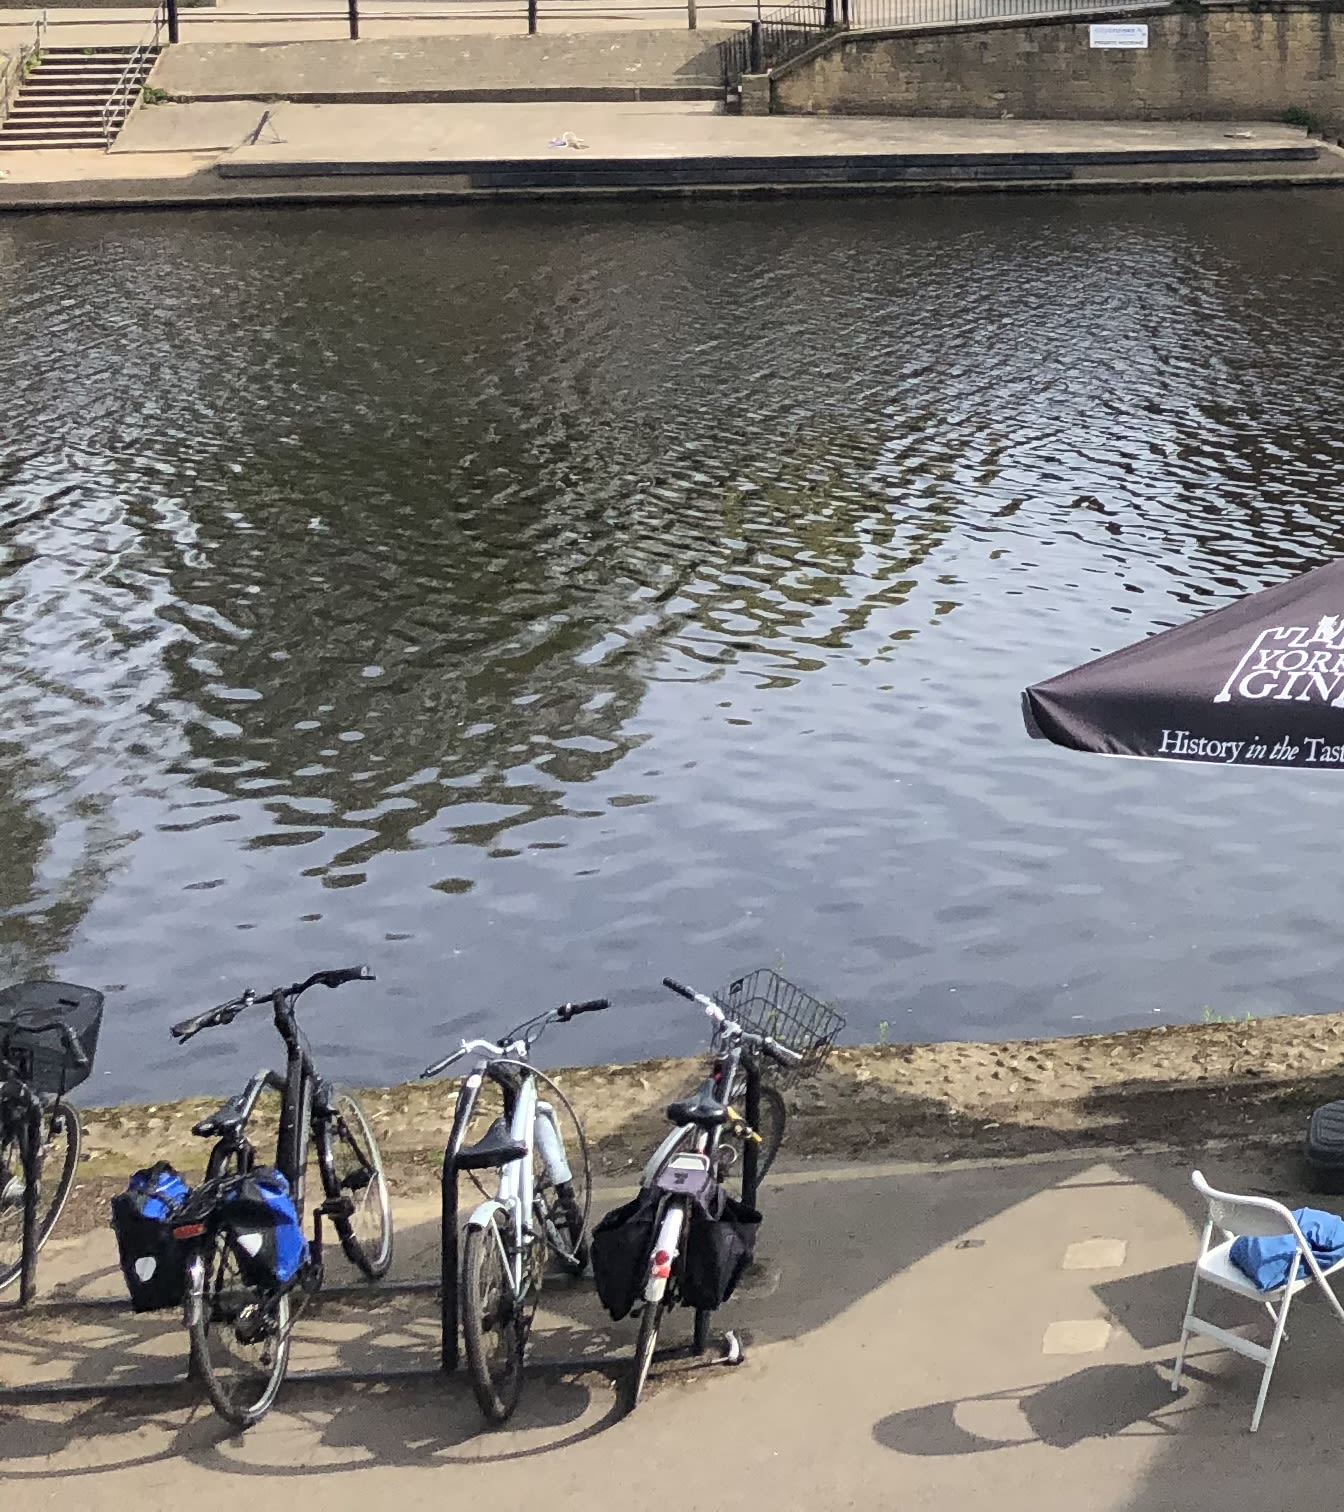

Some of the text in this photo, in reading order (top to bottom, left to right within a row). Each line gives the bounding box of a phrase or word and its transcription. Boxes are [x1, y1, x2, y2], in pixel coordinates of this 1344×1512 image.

[1158, 729, 1245, 763] History
[1246, 735, 1267, 760] in
[1269, 735, 1299, 761] the
